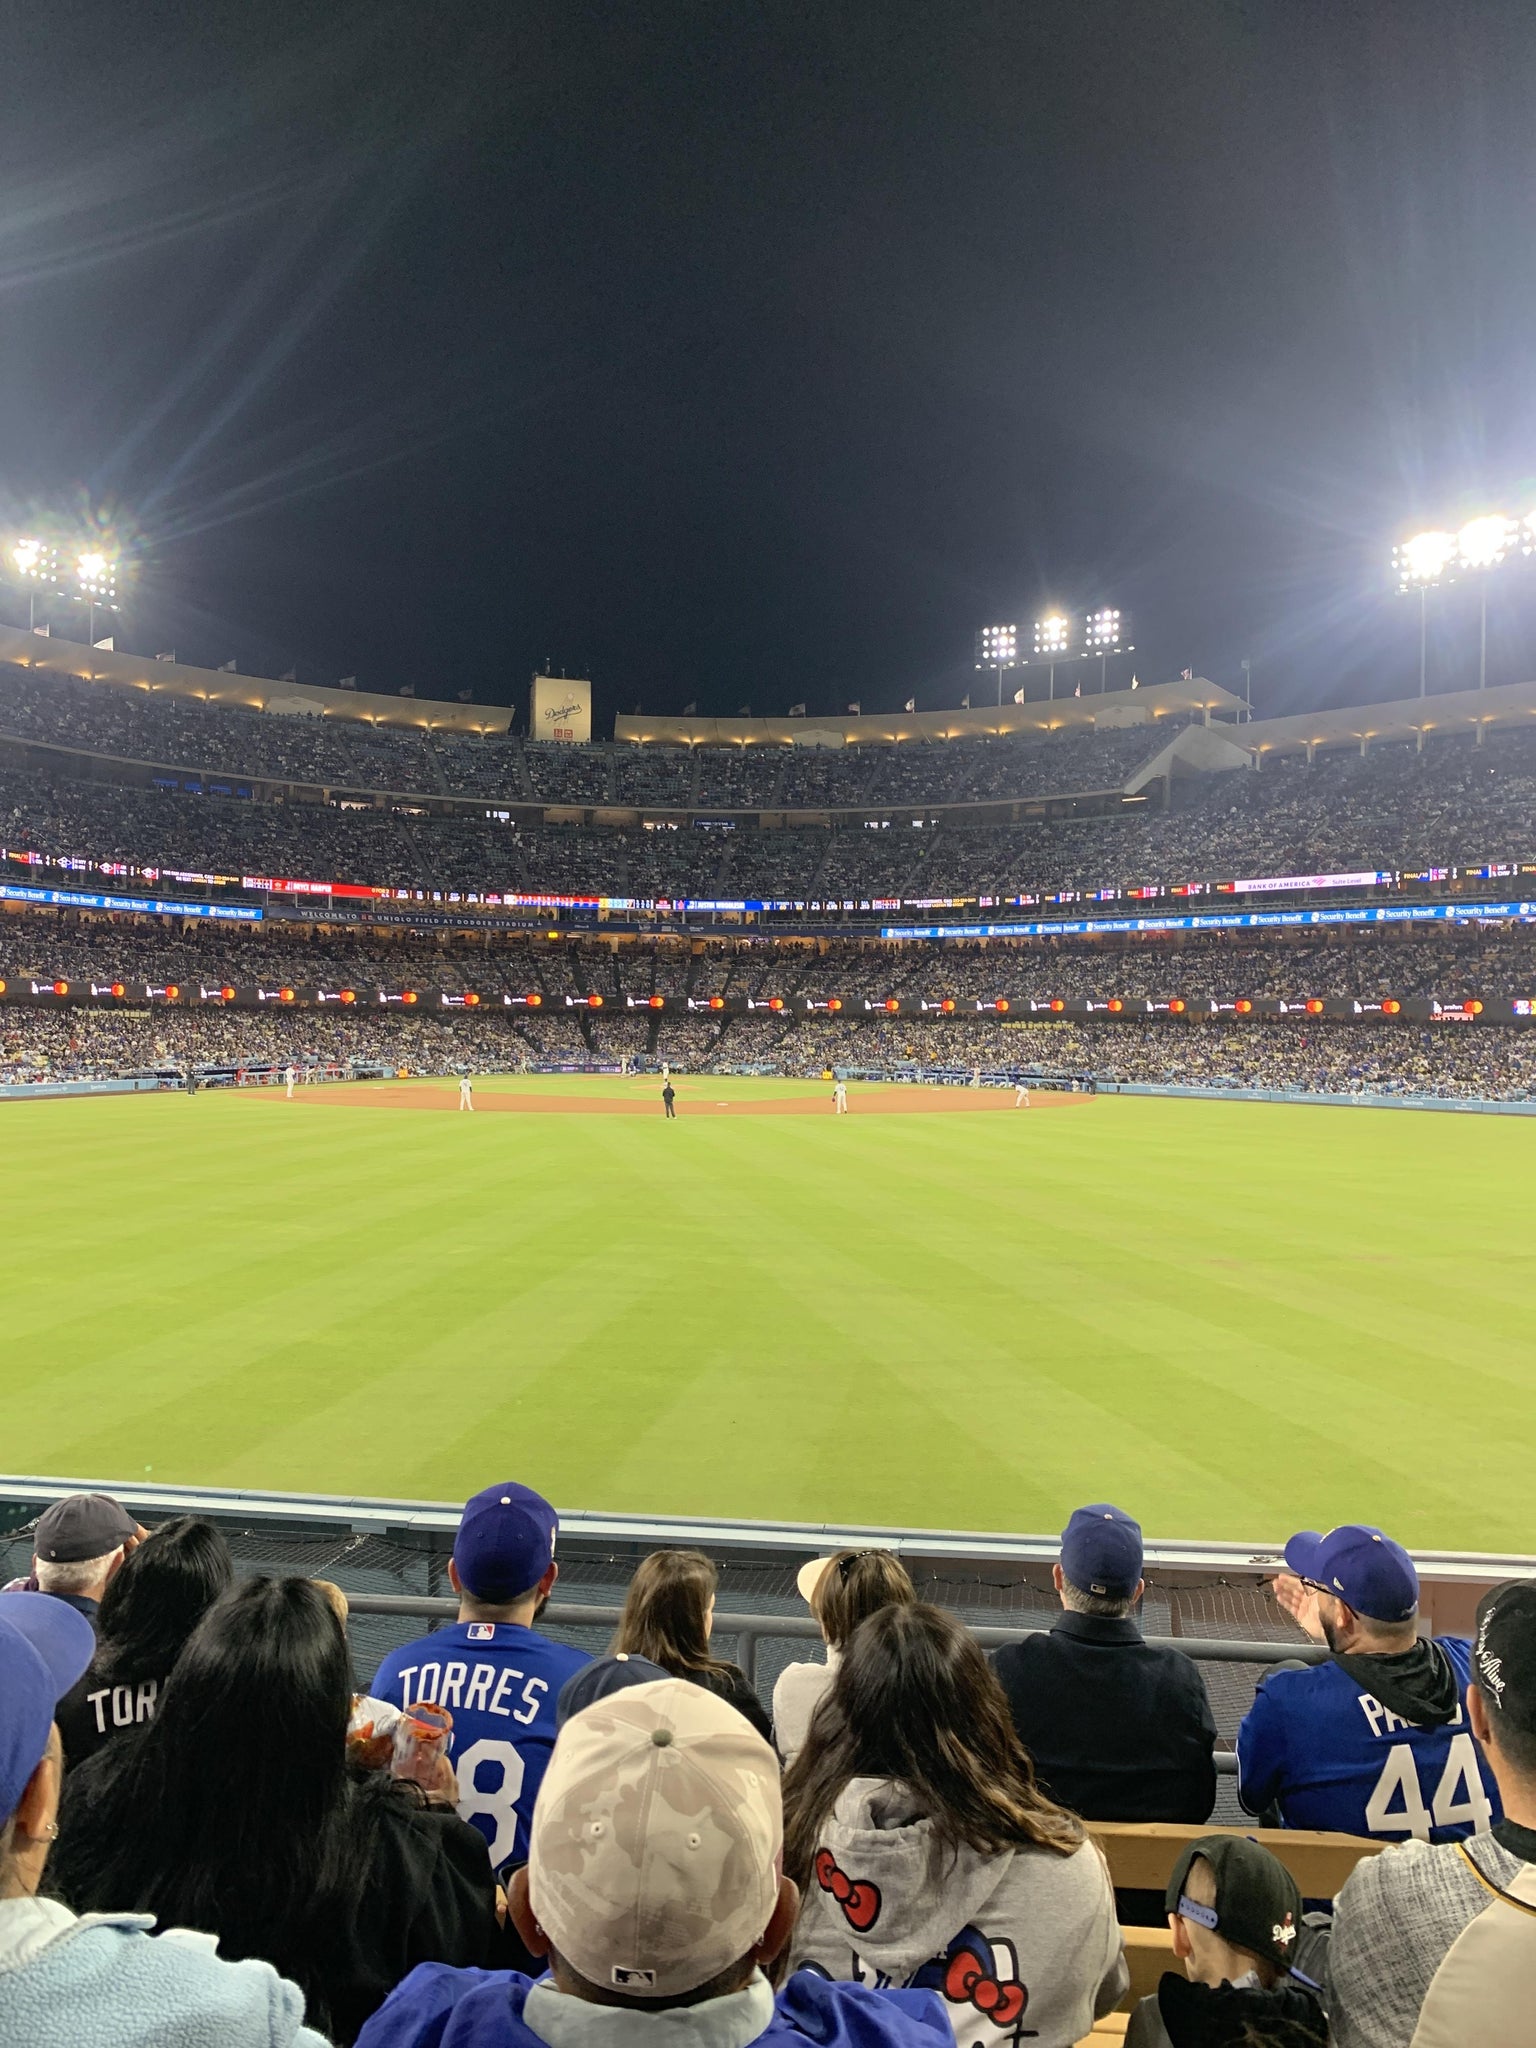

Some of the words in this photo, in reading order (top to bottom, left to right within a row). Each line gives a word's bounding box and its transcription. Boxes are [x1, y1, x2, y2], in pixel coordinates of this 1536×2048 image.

[544, 703, 583, 722] Dodgers
[293, 882, 309, 891] BRYCE
[310, 884, 332, 893] HARPER
[6, 889, 26, 899] Security
[28, 891, 45, 899] Benefit
[163, 905, 182, 913] Security
[217, 909, 236, 917] Security
[1386, 910, 1411, 919] Security
[1412, 909, 1437, 917] Benefit
[1455, 907, 1483, 916] Security
[1484, 906, 1510, 914] Benefit
[301, 911, 346, 920] WELCOME
[1258, 916, 1281, 924] Security
[1320, 913, 1344, 921] Security
[1200, 919, 1220, 927] Security
[1222, 917, 1242, 925] Benefit
[398, 1662, 549, 1725] TORRES
[87, 1679, 160, 1733] TOR
[1365, 1732, 1493, 1843] 44
[456, 1738, 525, 1870] 8
